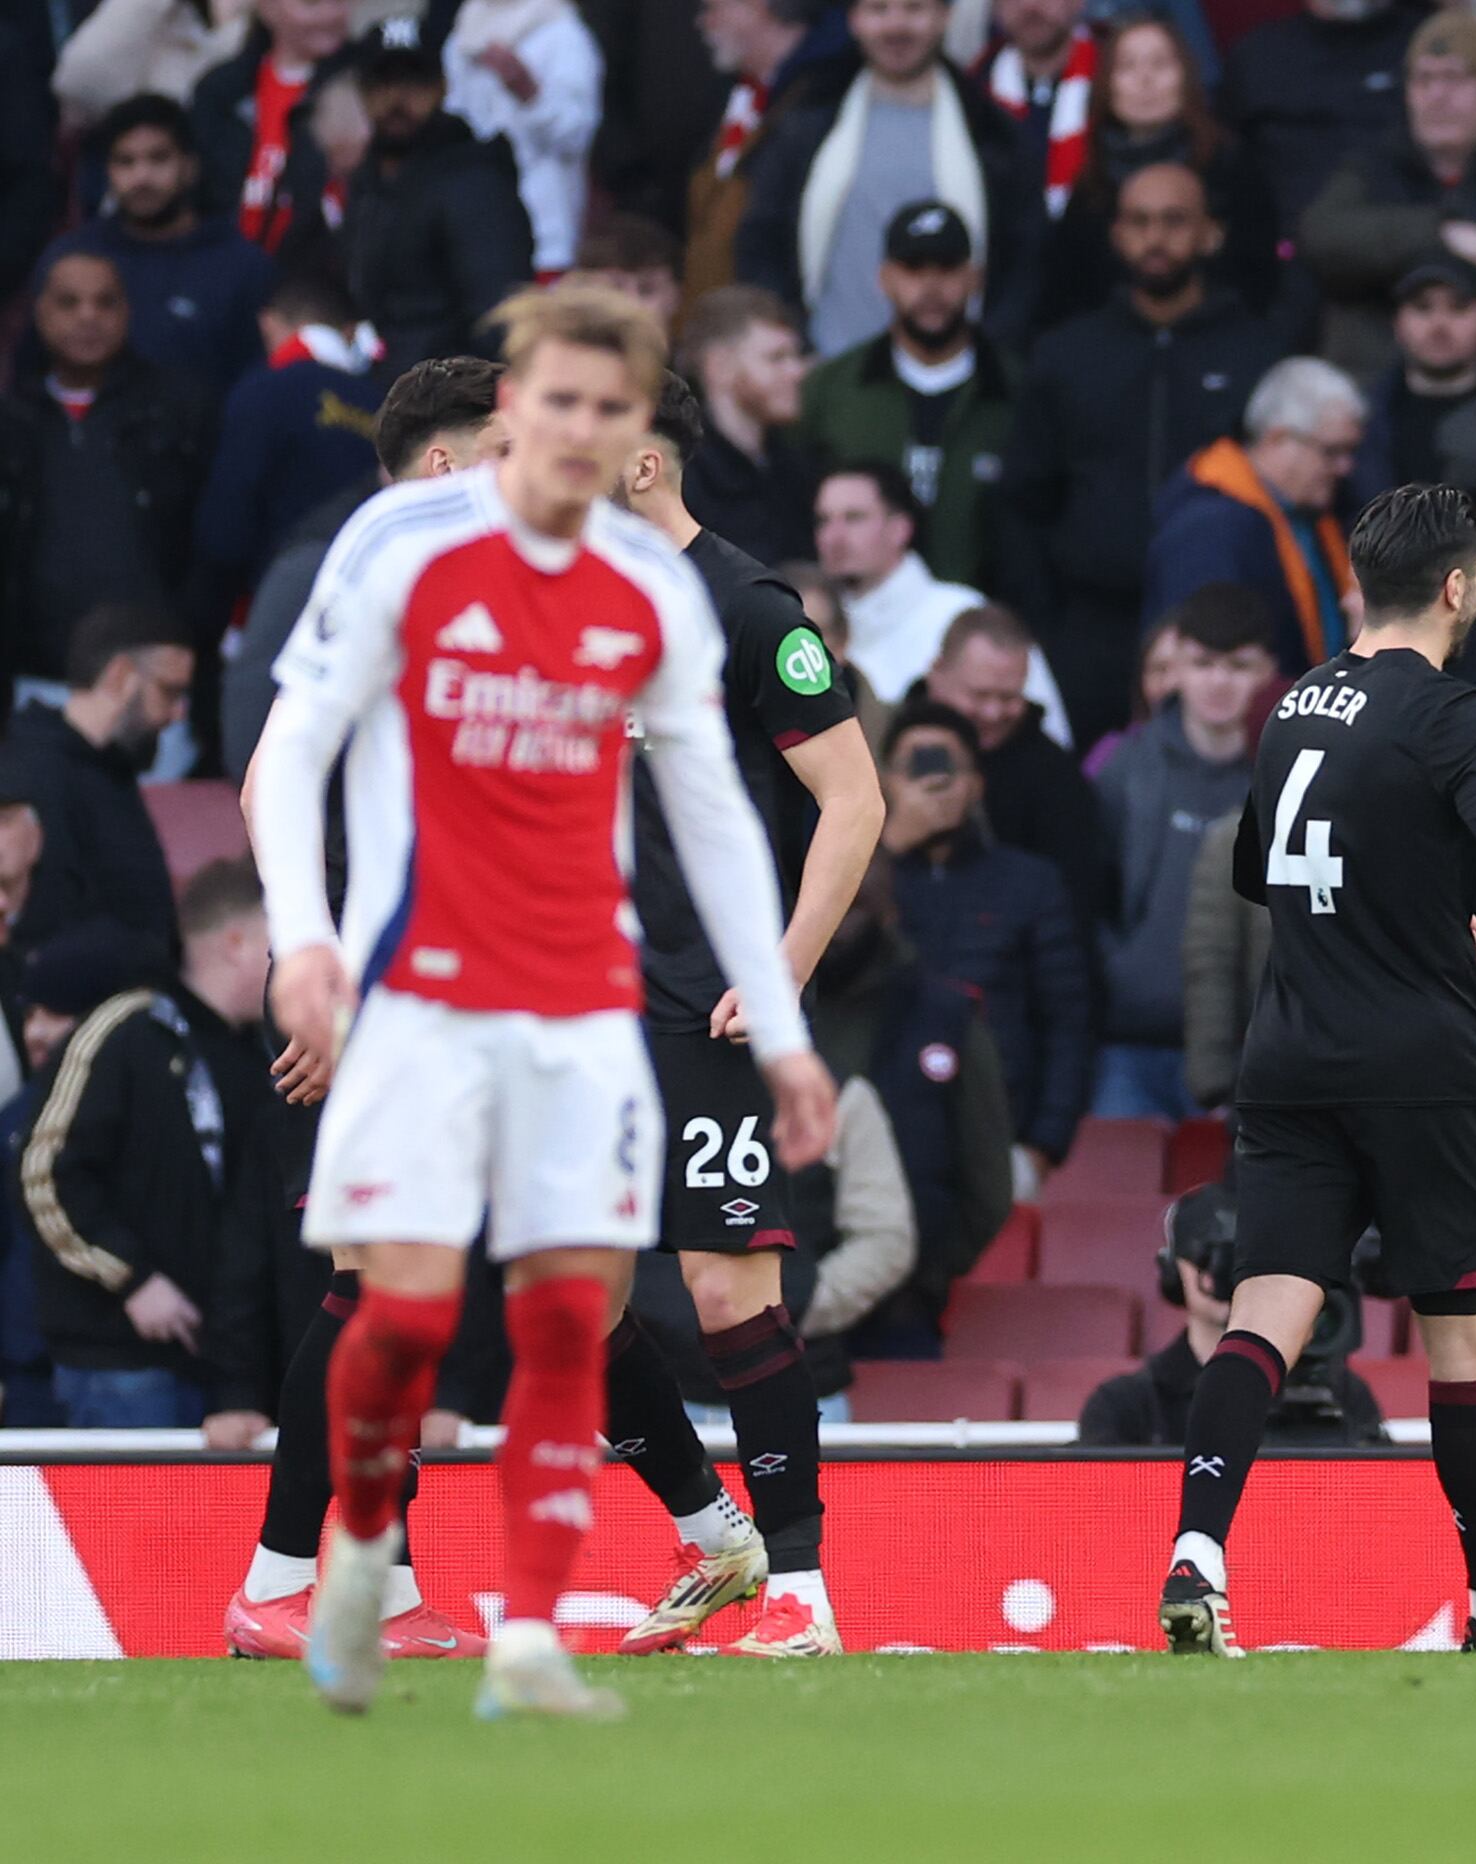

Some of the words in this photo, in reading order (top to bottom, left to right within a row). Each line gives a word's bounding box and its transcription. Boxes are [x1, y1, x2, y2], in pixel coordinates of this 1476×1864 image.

[1277, 685, 1368, 726] SOLER
[1266, 749, 1343, 914] 4
[682, 1115, 771, 1188] 26
